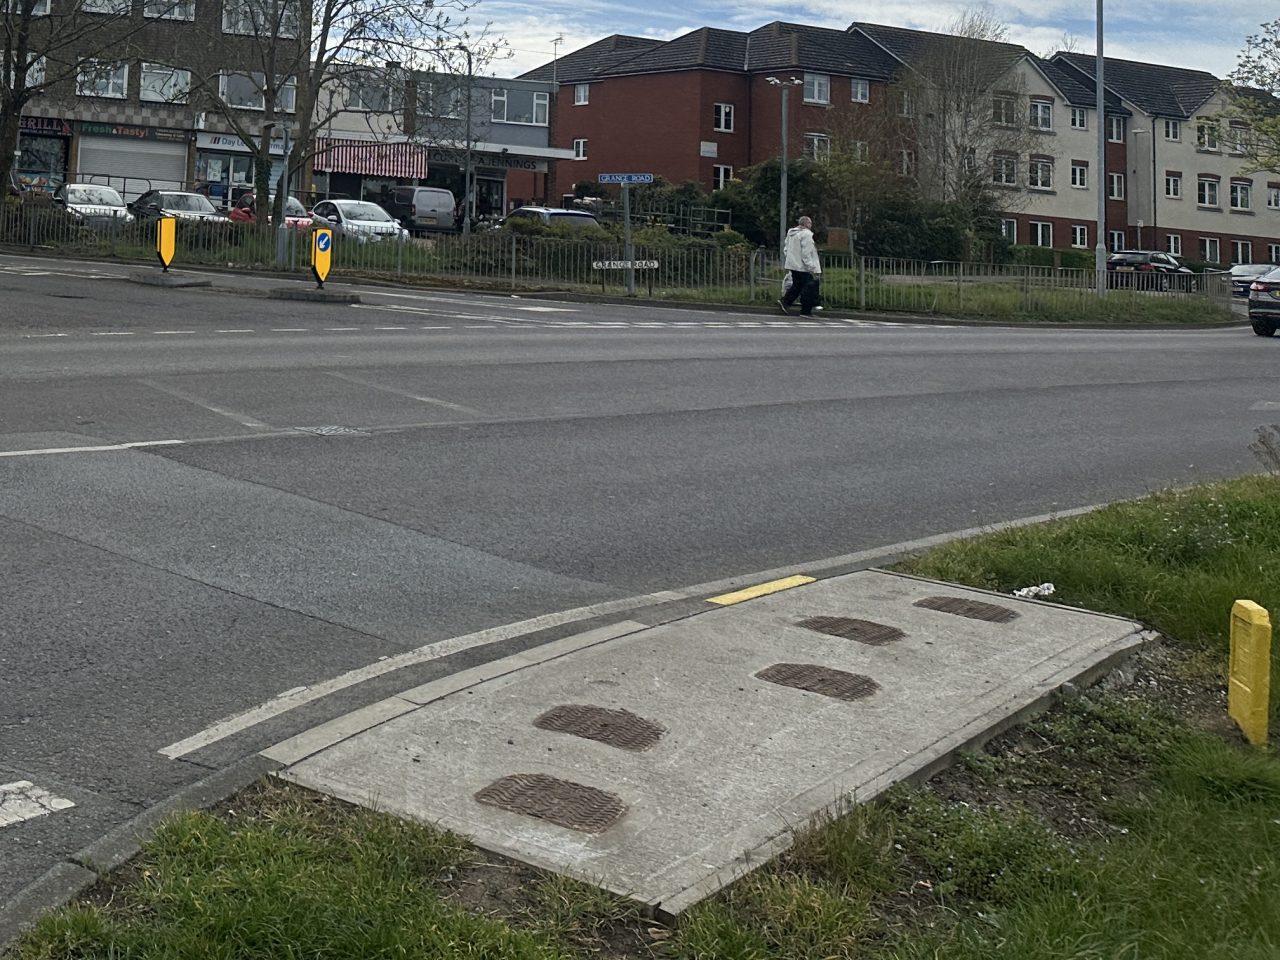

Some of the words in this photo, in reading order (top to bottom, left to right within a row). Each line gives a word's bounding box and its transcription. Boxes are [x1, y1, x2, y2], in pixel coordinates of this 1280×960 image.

[19, 118, 61, 129] GRILL
[221, 137, 236, 146] Day
[486, 158, 537, 170] JENNINGS
[634, 261, 656, 269] ROAD
